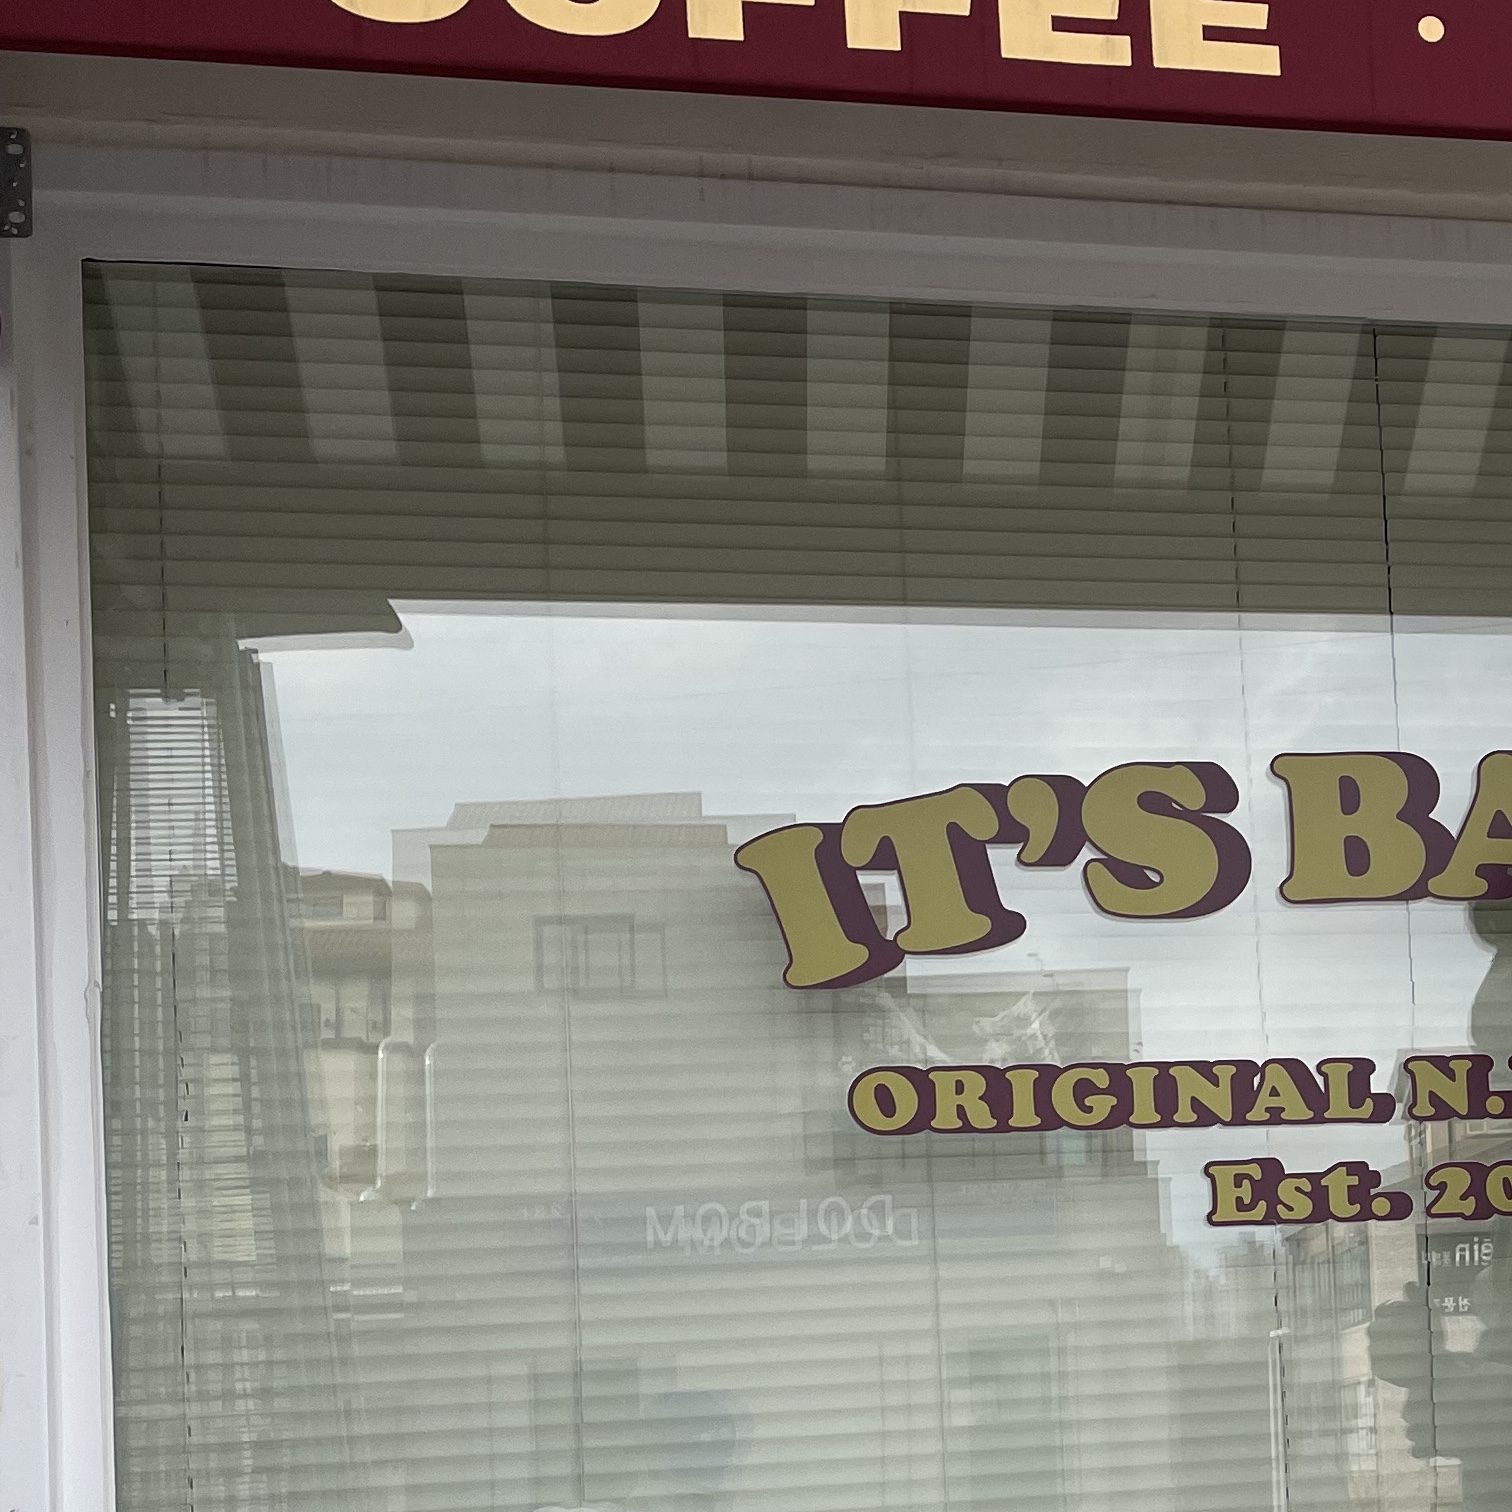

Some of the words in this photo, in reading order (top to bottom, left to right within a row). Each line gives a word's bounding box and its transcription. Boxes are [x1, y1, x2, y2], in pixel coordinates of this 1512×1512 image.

[734, 761, 1252, 989] IT'S
[848, 1058, 1396, 1135] ORIGINAL
[1204, 1157, 1413, 1226] Est.
